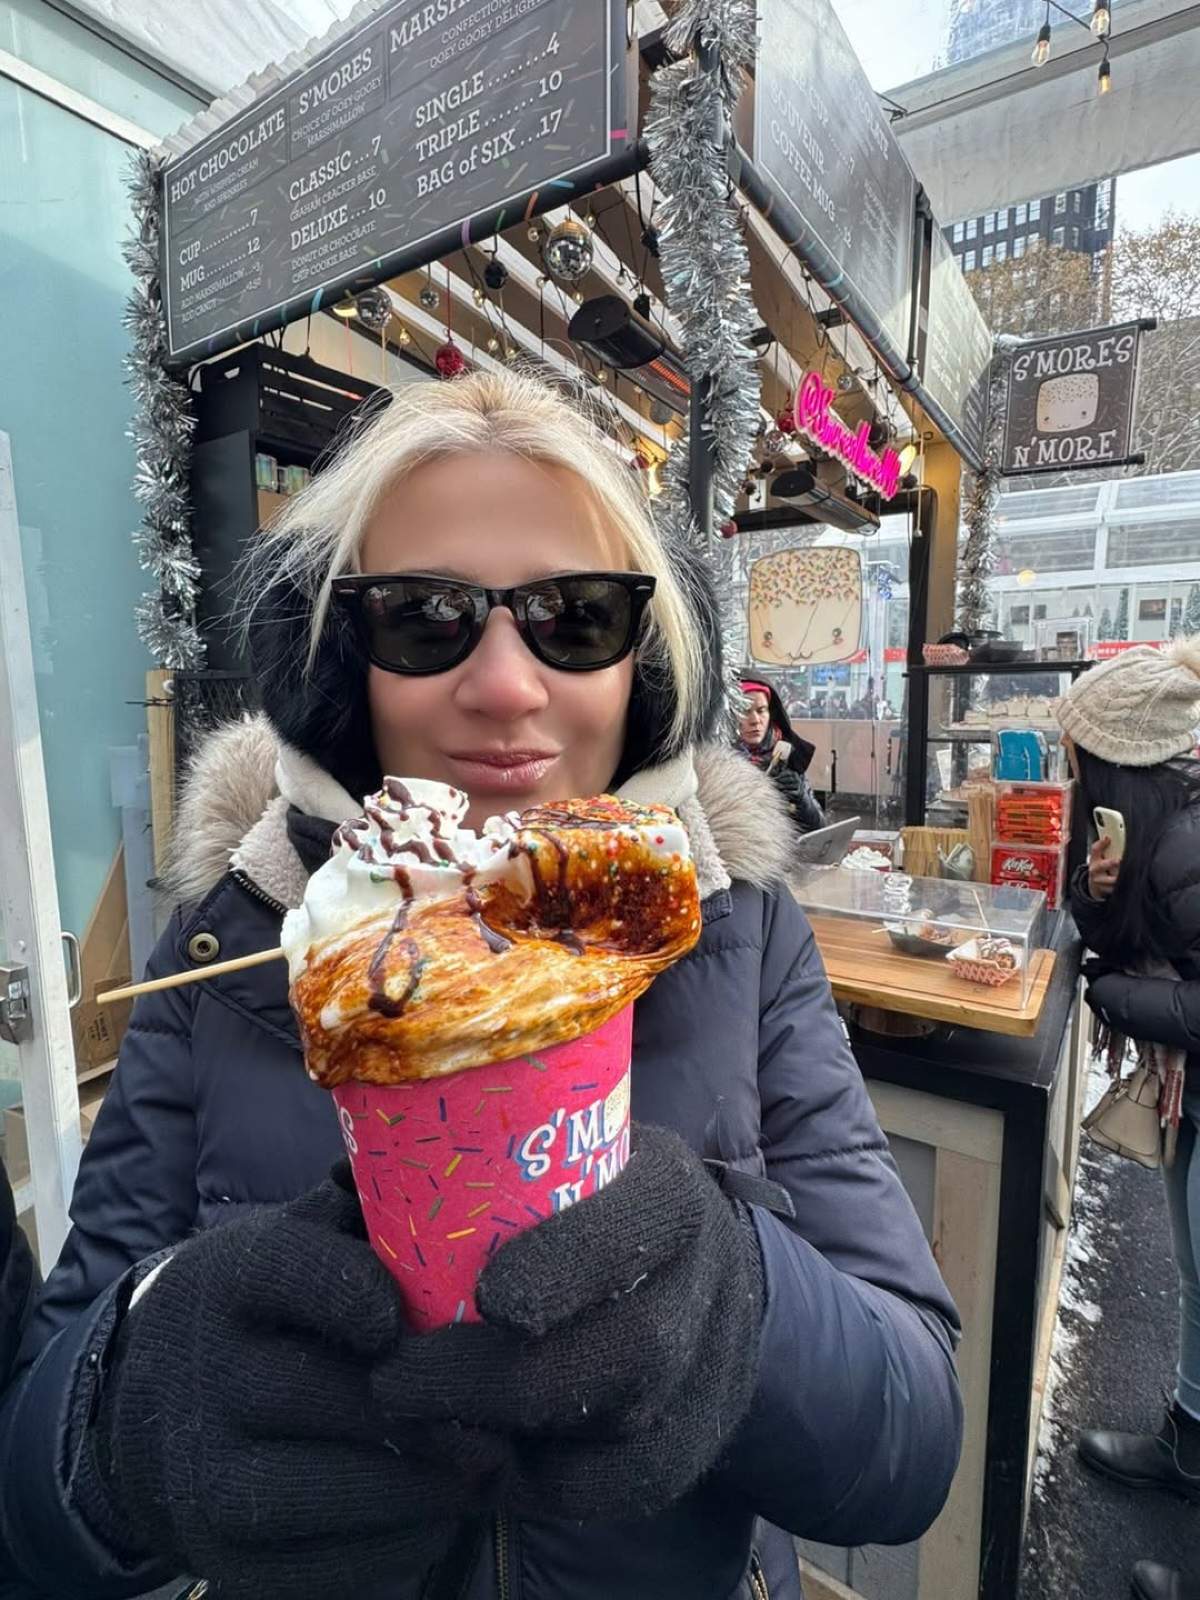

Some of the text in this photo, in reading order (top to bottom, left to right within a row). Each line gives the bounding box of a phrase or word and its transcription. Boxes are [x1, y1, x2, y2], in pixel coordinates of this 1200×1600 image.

[299, 47, 372, 114] S'MORES
[415, 31, 560, 128] SINGLE 4
[416, 70, 563, 162] TRIPLE 10
[171, 108, 285, 204] HOT CHOCOLATE
[289, 135, 381, 201] CLASSIC 7
[416, 108, 562, 198] BAG of SIX 17
[770, 119, 812, 192] COFFEE
[812, 177, 835, 222] MUG
[180, 208, 258, 265] CUP 7
[290, 188, 386, 250] DELUXE 10
[329, 220, 377, 251] CHOCOLATE
[180, 237, 261, 292] MUG 12
[1013, 335, 1133, 381] S'MORES
[1012, 429, 1117, 468] N'MORE
